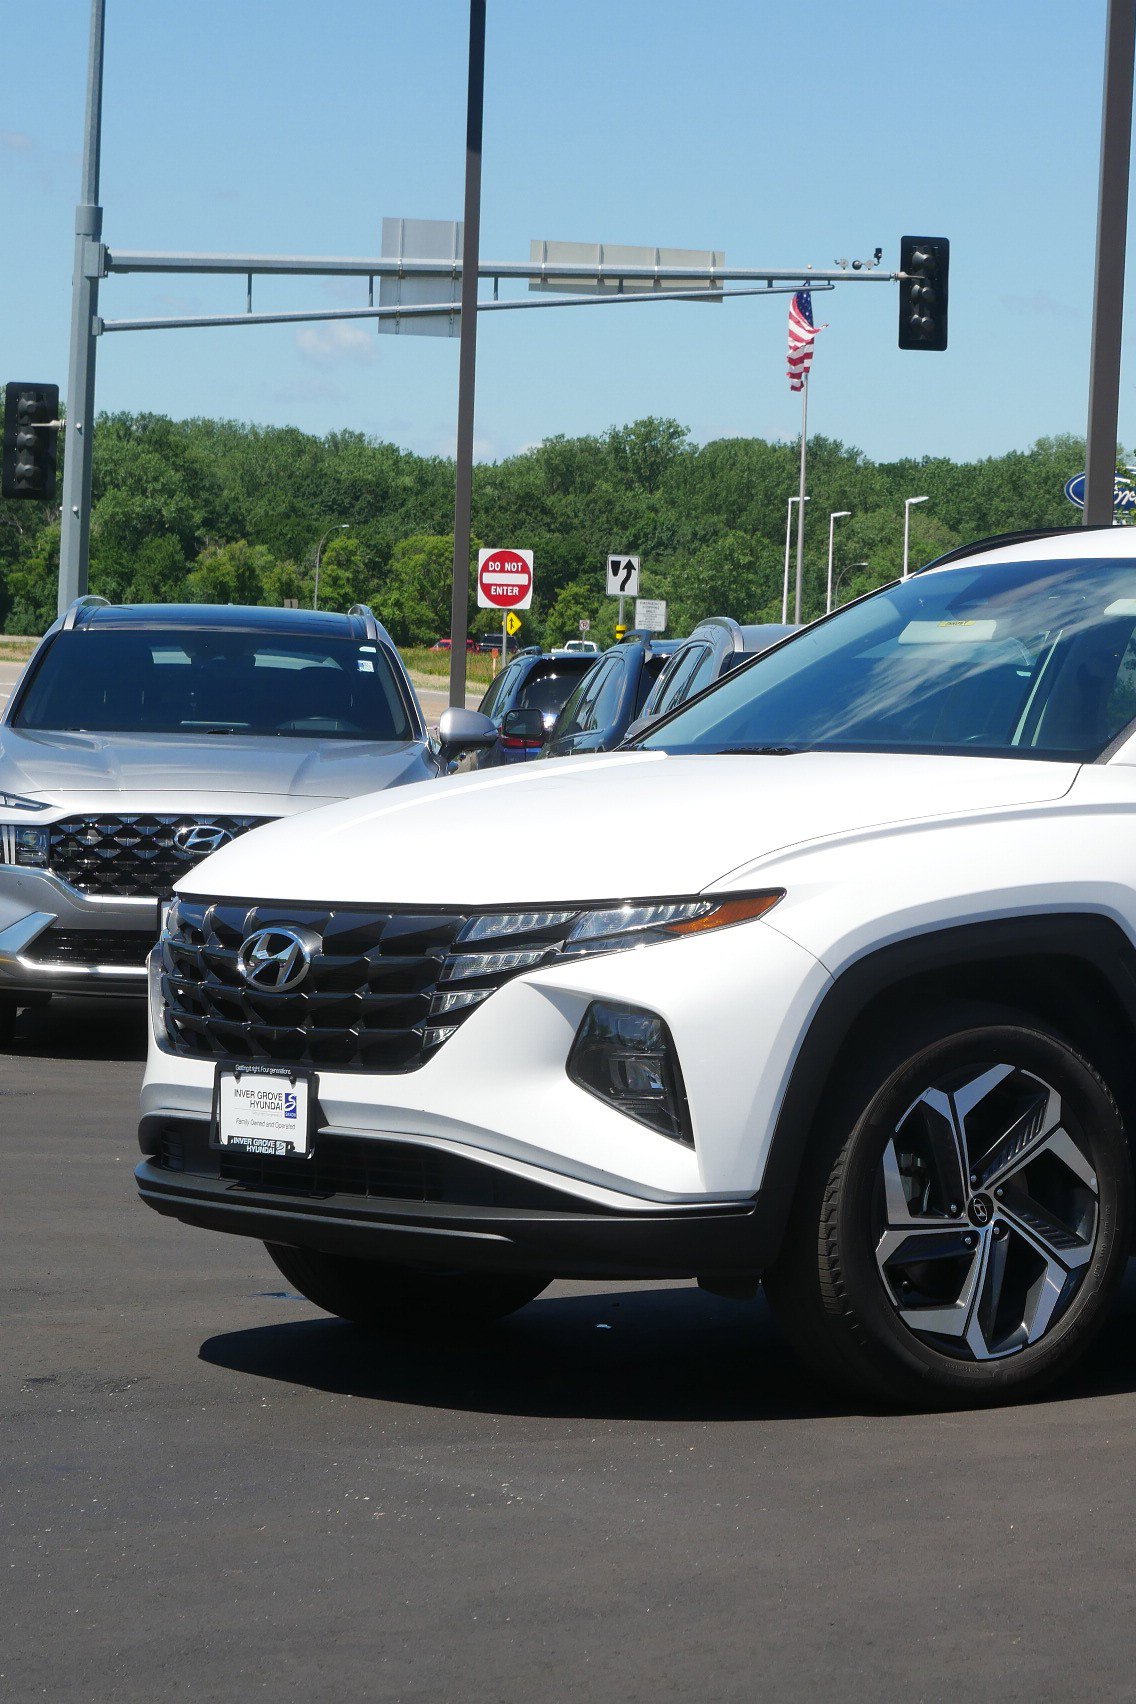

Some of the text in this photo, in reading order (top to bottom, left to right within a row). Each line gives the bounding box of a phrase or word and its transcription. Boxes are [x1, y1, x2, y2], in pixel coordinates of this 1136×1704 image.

[489, 561, 522, 571] DO NOT
[491, 586, 519, 596] ENTER
[234, 1089, 282, 1101] INVER GROVE
[250, 1100, 282, 1110] HYUNDAI
[236, 1117, 249, 1126] Family
[275, 1122, 295, 1130] Operated
[233, 1137, 275, 1147] INVER GROVE
[247, 1145, 275, 1154] HYUNDAI
